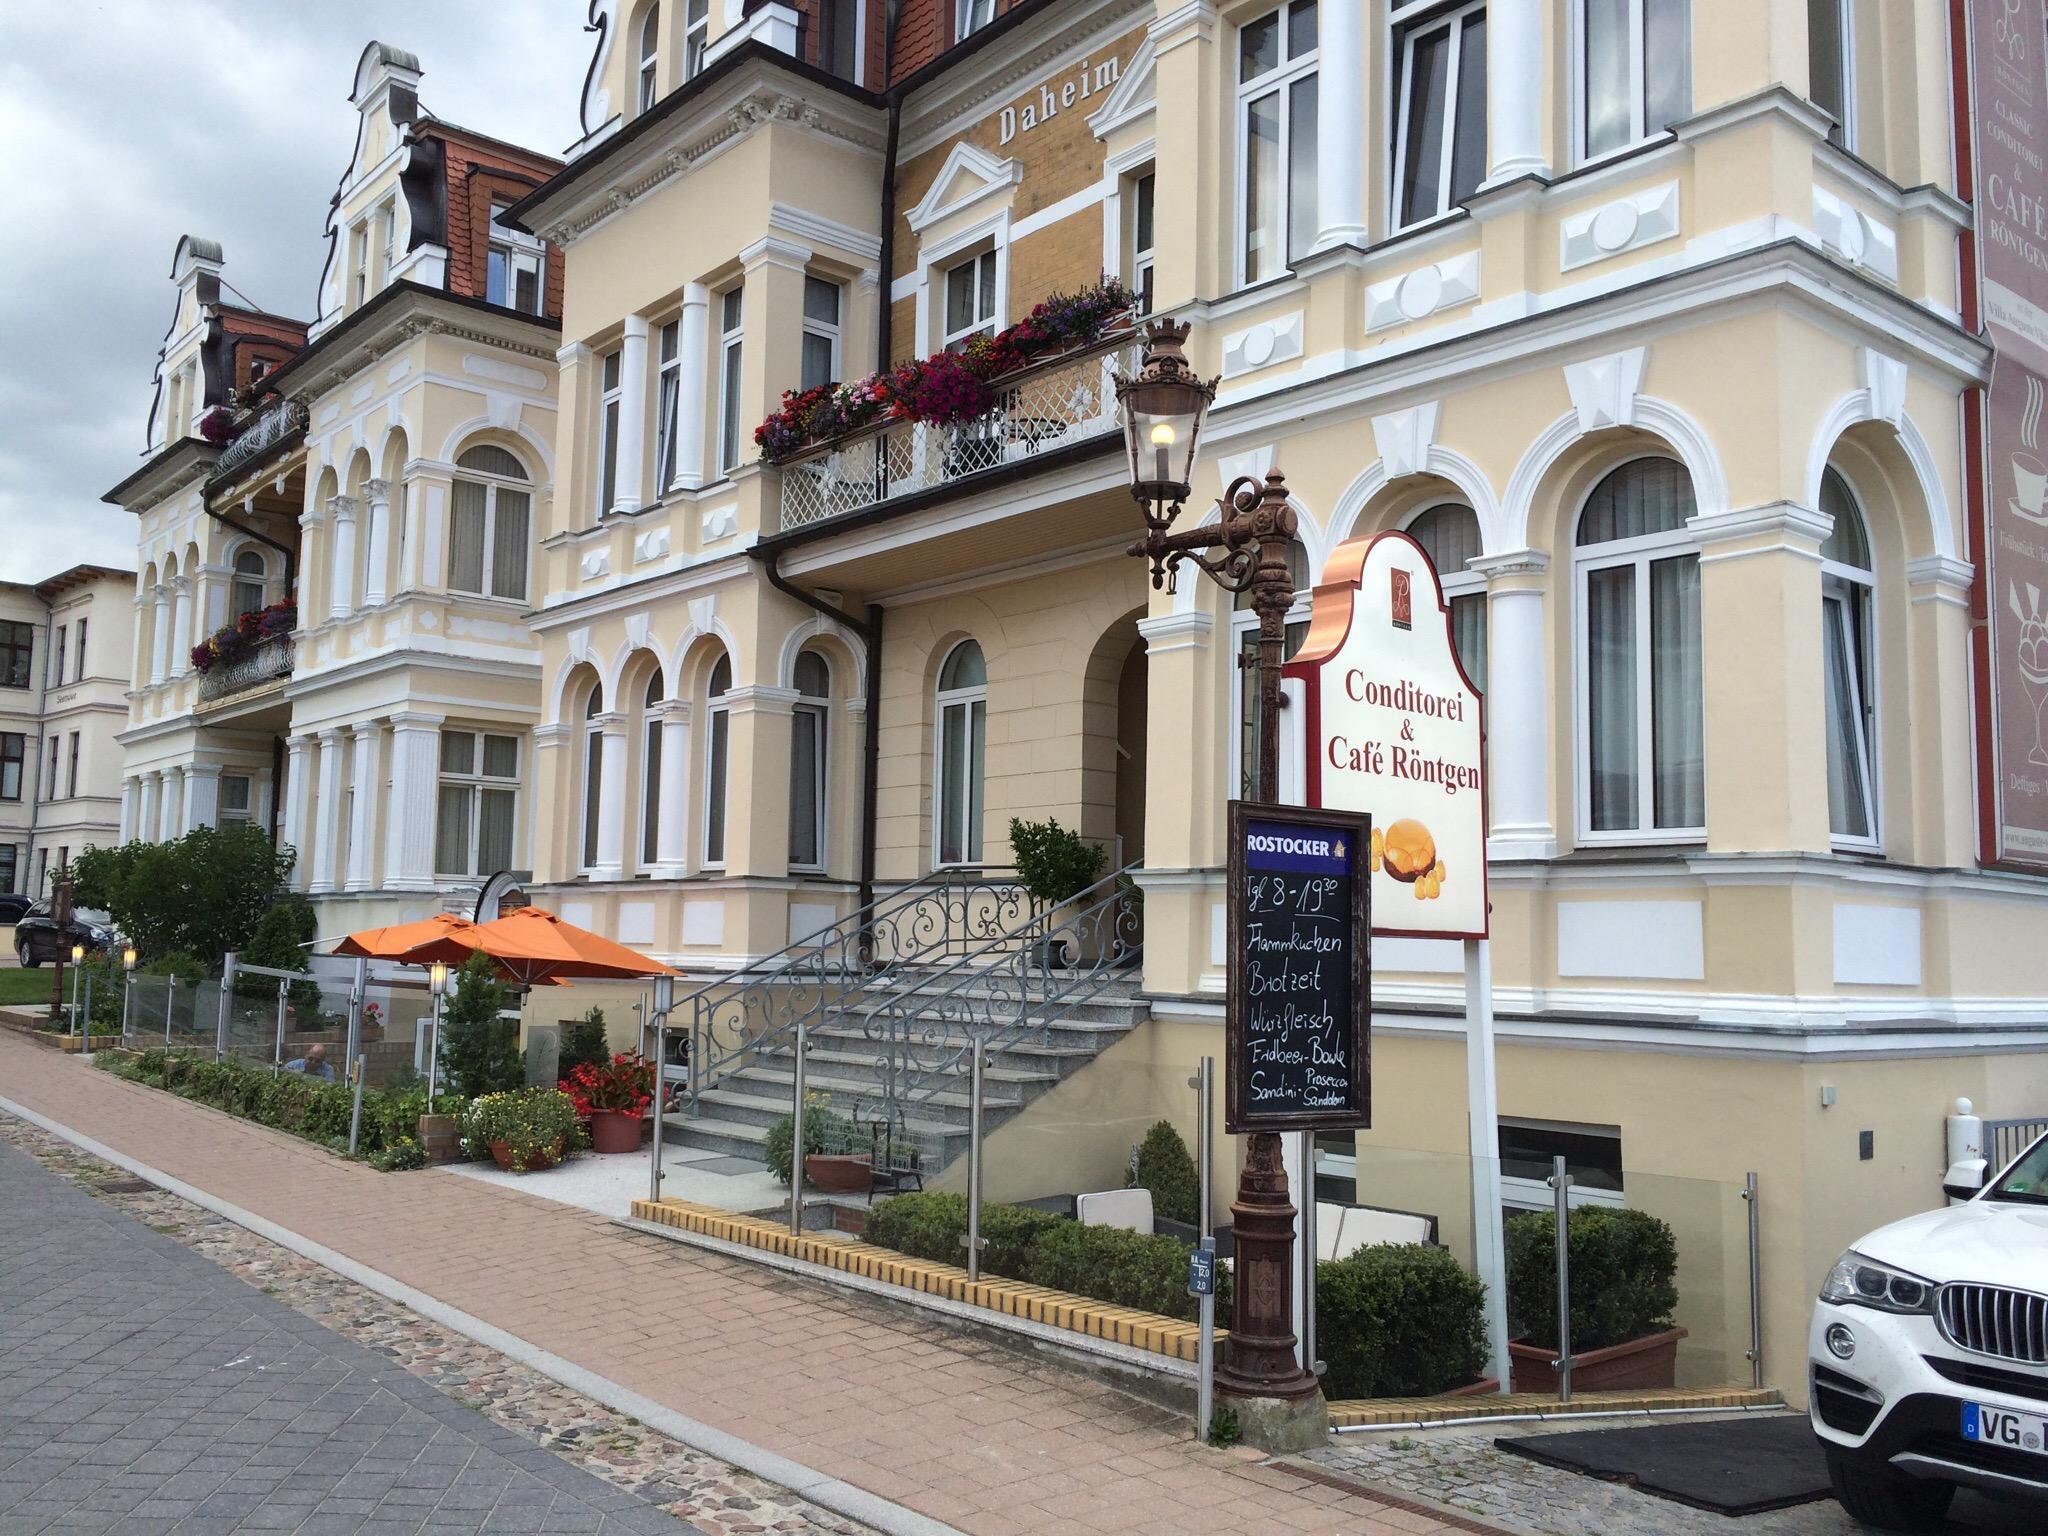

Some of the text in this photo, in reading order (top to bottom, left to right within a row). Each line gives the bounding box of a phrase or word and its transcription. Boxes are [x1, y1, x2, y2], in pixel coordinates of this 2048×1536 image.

[999, 56, 1121, 146] Daheim
[1995, 98, 2033, 139] CLASSIC
[1987, 120, 2044, 173] CONDITOREI
[1988, 173, 2048, 241] CAFÉ
[1990, 218, 2048, 272] RÖNTGEN
[1345, 668, 1464, 722] Conditorei
[1400, 718, 1414, 742] &
[1328, 735, 1480, 795] Café Röntgen
[1247, 834, 1330, 857] ROSTOCKER
[1247, 921, 1342, 953] Flammkuchen
[1247, 956, 1322, 996] Brotzeit
[1250, 998, 1334, 1043] Würzfleisch
[1967, 1424, 1975, 1433] D
[1981, 1410, 2020, 1445] VG
